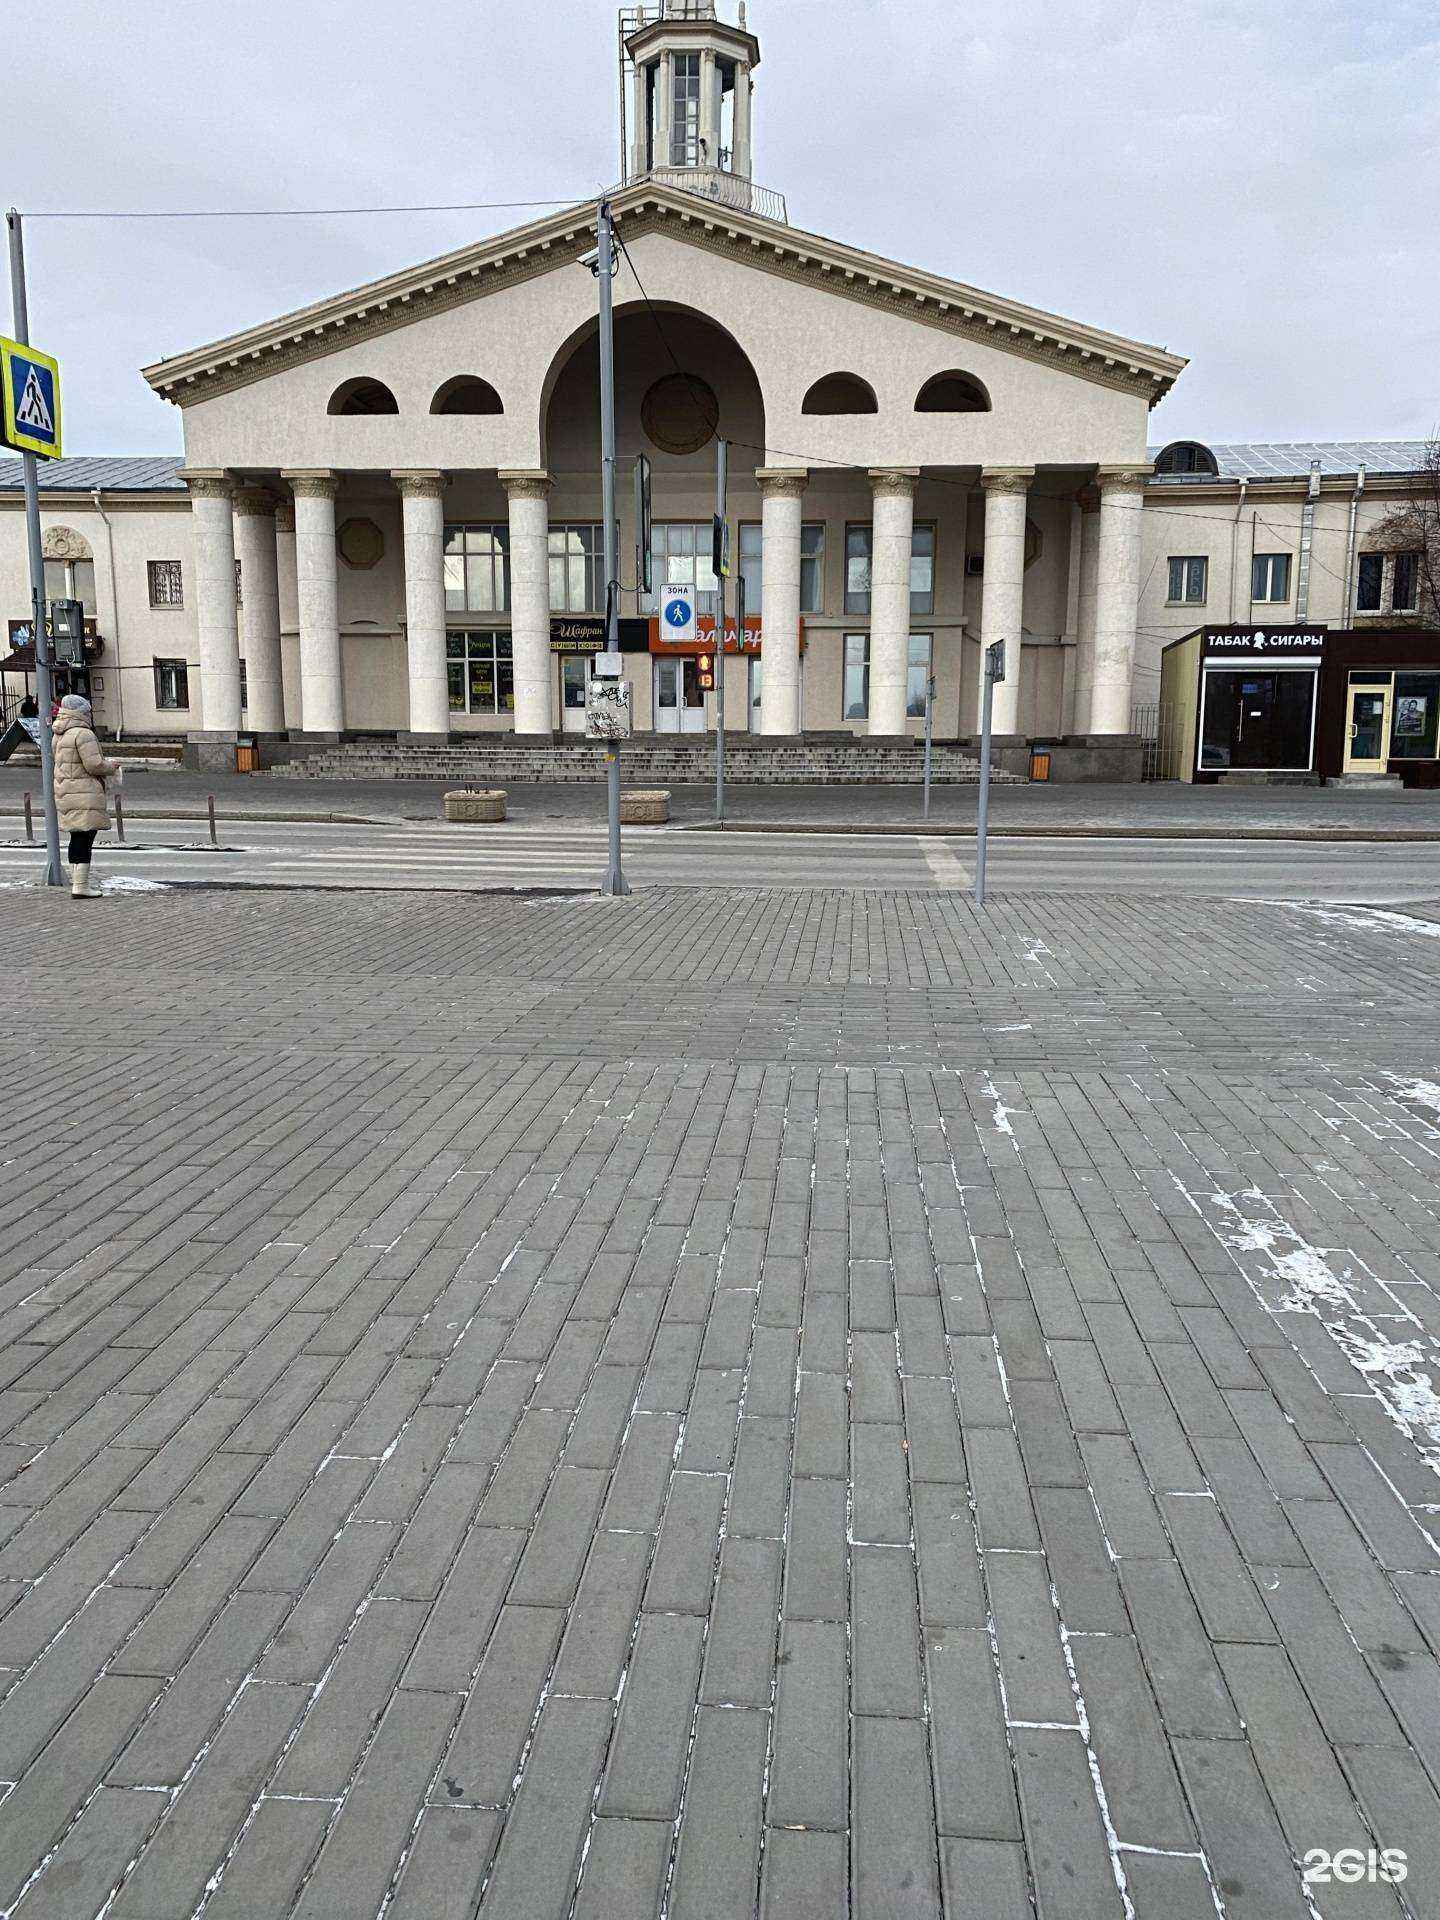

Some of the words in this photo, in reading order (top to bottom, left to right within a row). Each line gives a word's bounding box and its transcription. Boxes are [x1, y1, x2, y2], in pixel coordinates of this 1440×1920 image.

[667, 587, 689, 595] ЗОНА
[551, 623, 604, 639] Шафран
[1208, 635, 1251, 646] ТАБАК
[1269, 635, 1324, 646] СИГАРЫ
